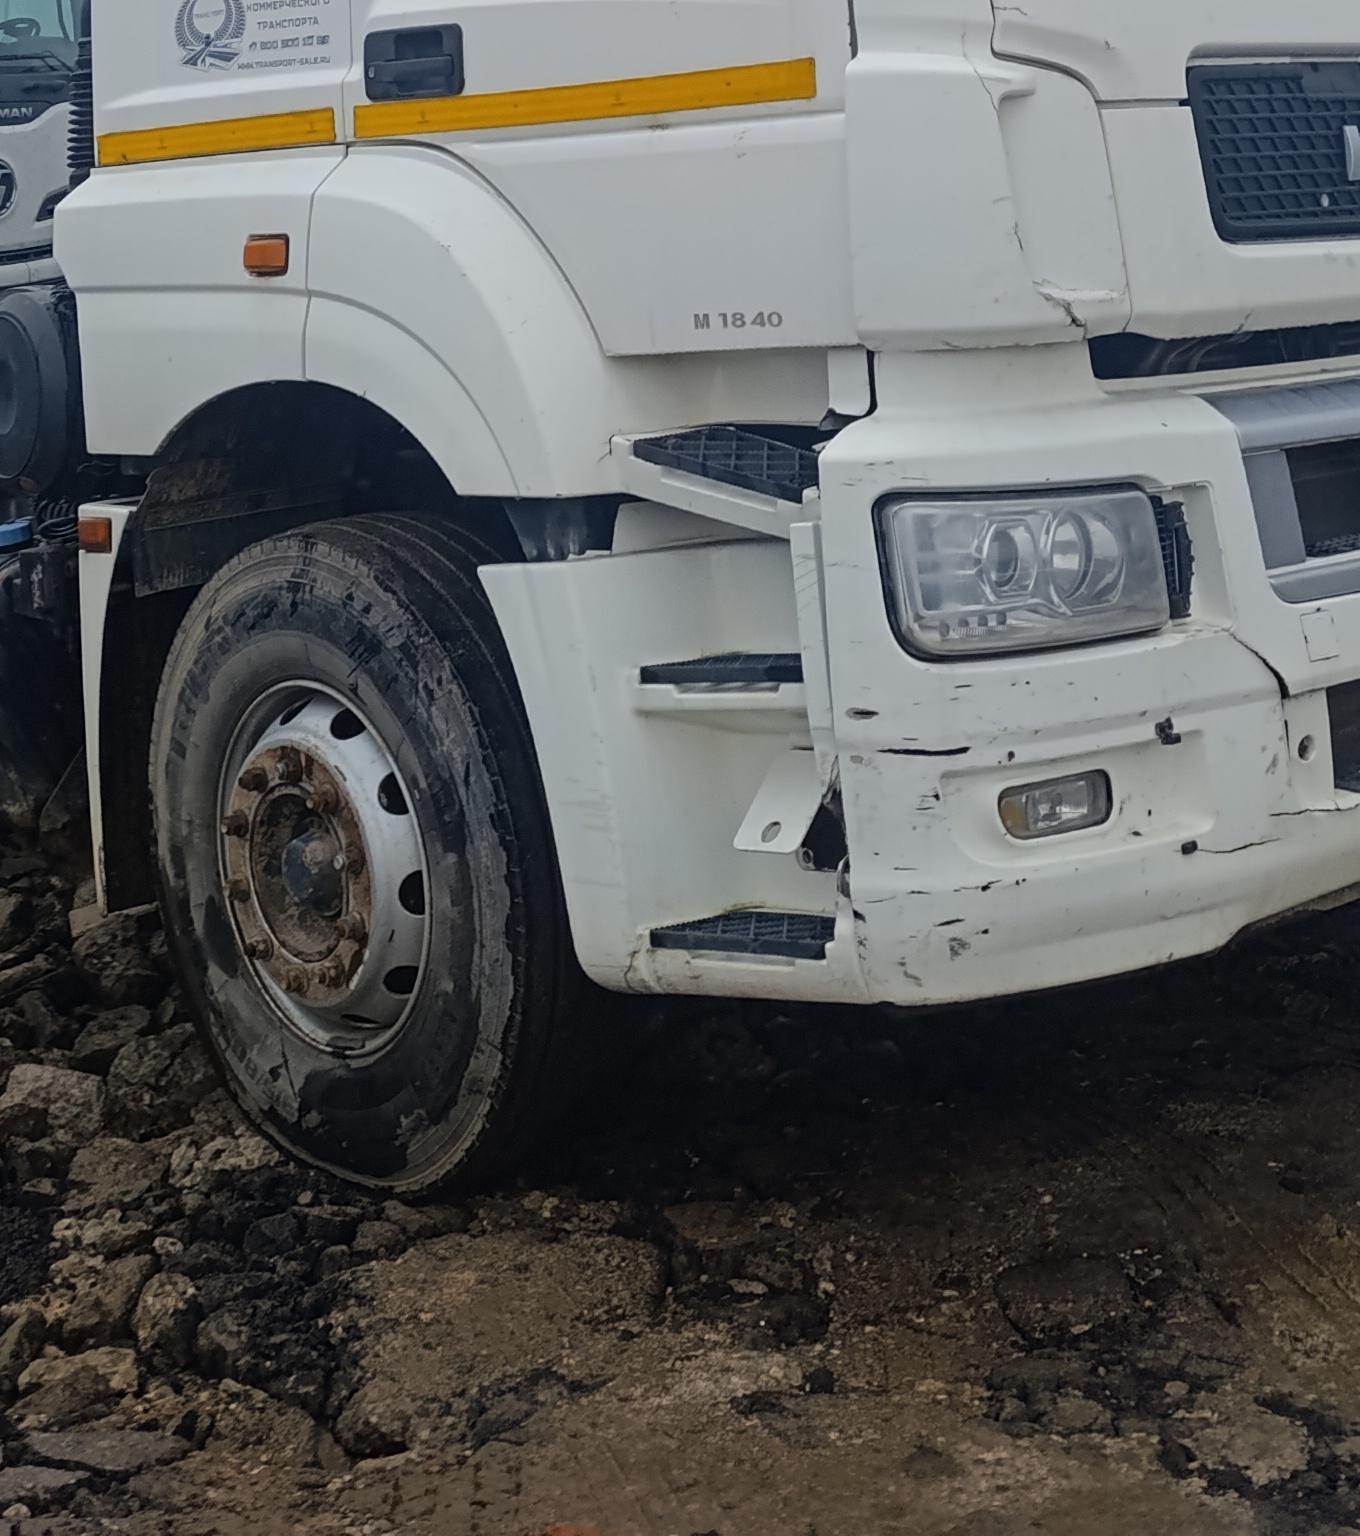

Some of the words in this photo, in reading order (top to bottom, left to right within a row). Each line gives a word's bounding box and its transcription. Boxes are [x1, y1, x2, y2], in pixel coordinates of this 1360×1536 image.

[257, 16, 319, 31] ТРАНСПОРТА
[693, 313, 710, 330] M
[718, 311, 783, 329] 1840
